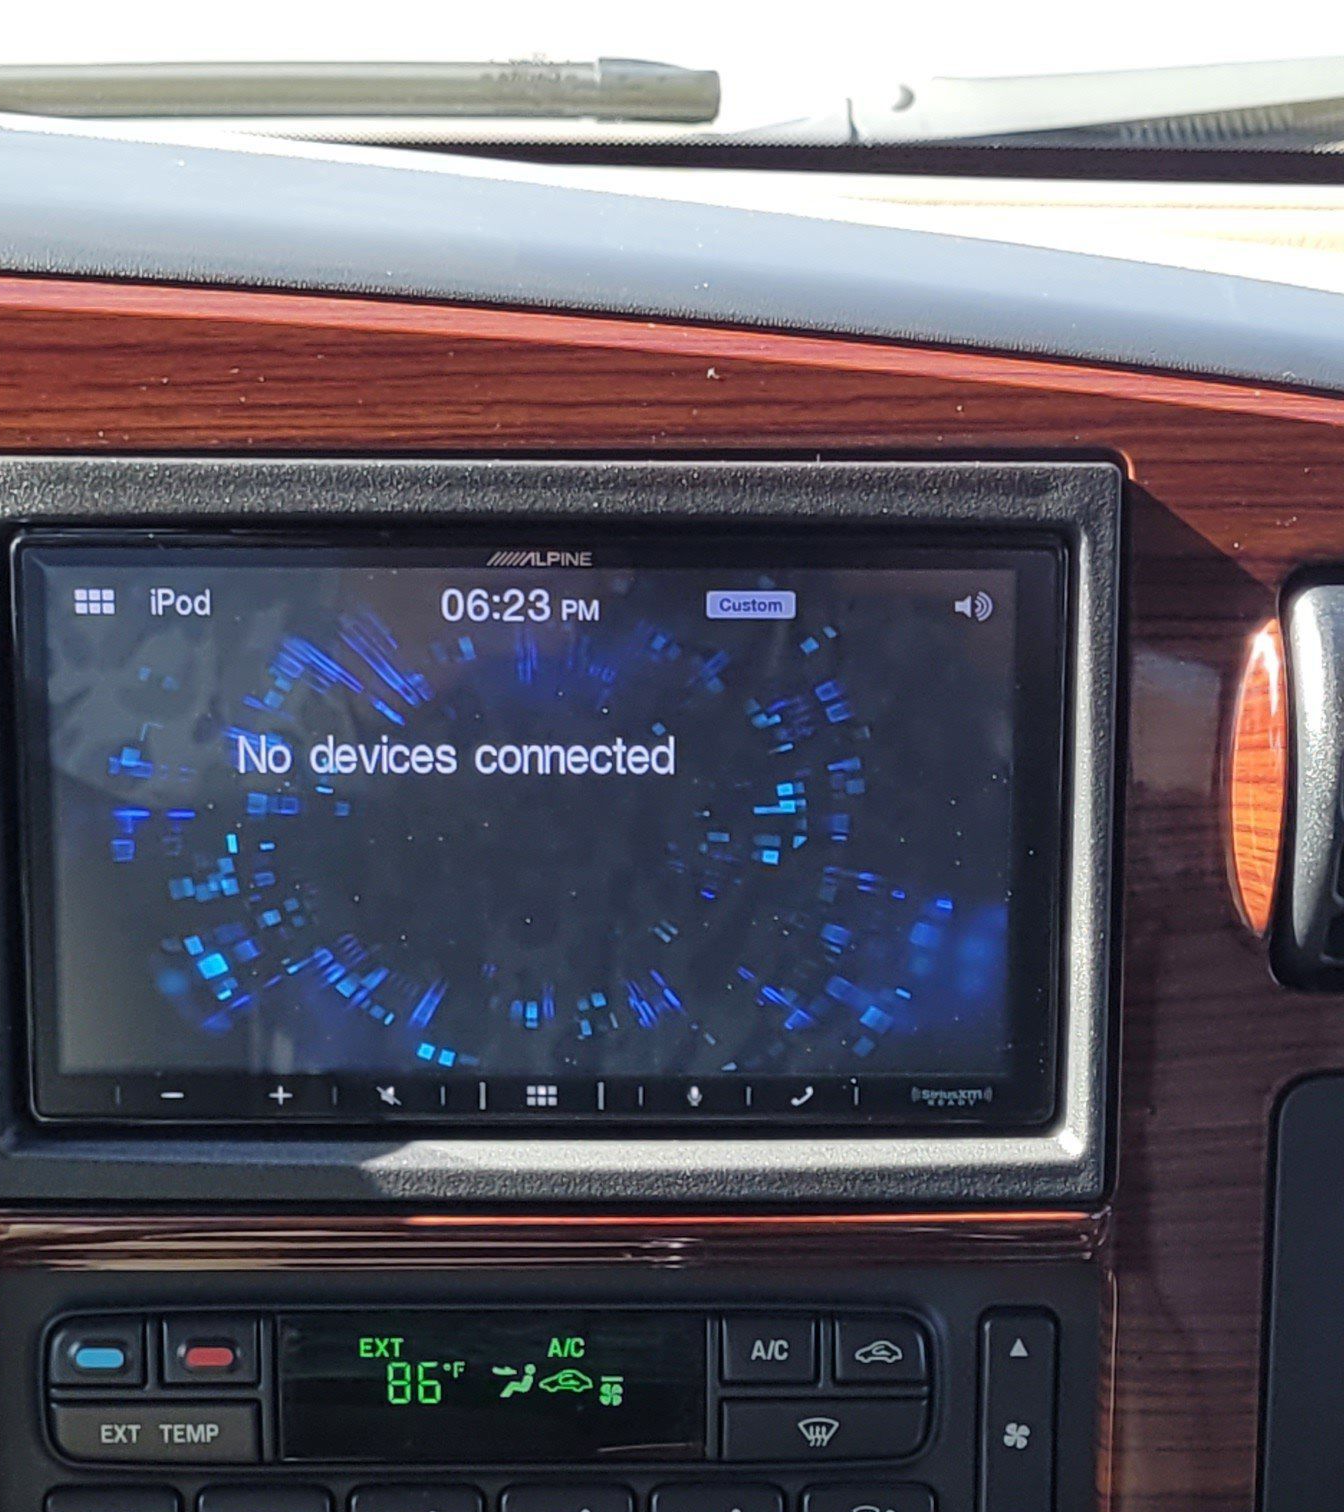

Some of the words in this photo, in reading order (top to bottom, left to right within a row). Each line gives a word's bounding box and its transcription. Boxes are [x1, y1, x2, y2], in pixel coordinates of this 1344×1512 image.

[487, 551, 593, 567] ALPINE
[150, 588, 211, 616] iPod
[441, 588, 551, 622] 06:23
[561, 599, 600, 621] PM
[719, 597, 783, 613] Custom
[237, 735, 292, 774] No
[309, 734, 457, 774] devices
[474, 736, 675, 775] connected
[359, 1337, 404, 1358] EXT
[547, 1337, 585, 1358] A/C
[750, 1339, 789, 1361] A/C
[100, 1424, 141, 1444] EXT
[159, 1423, 219, 1444] TEMP
